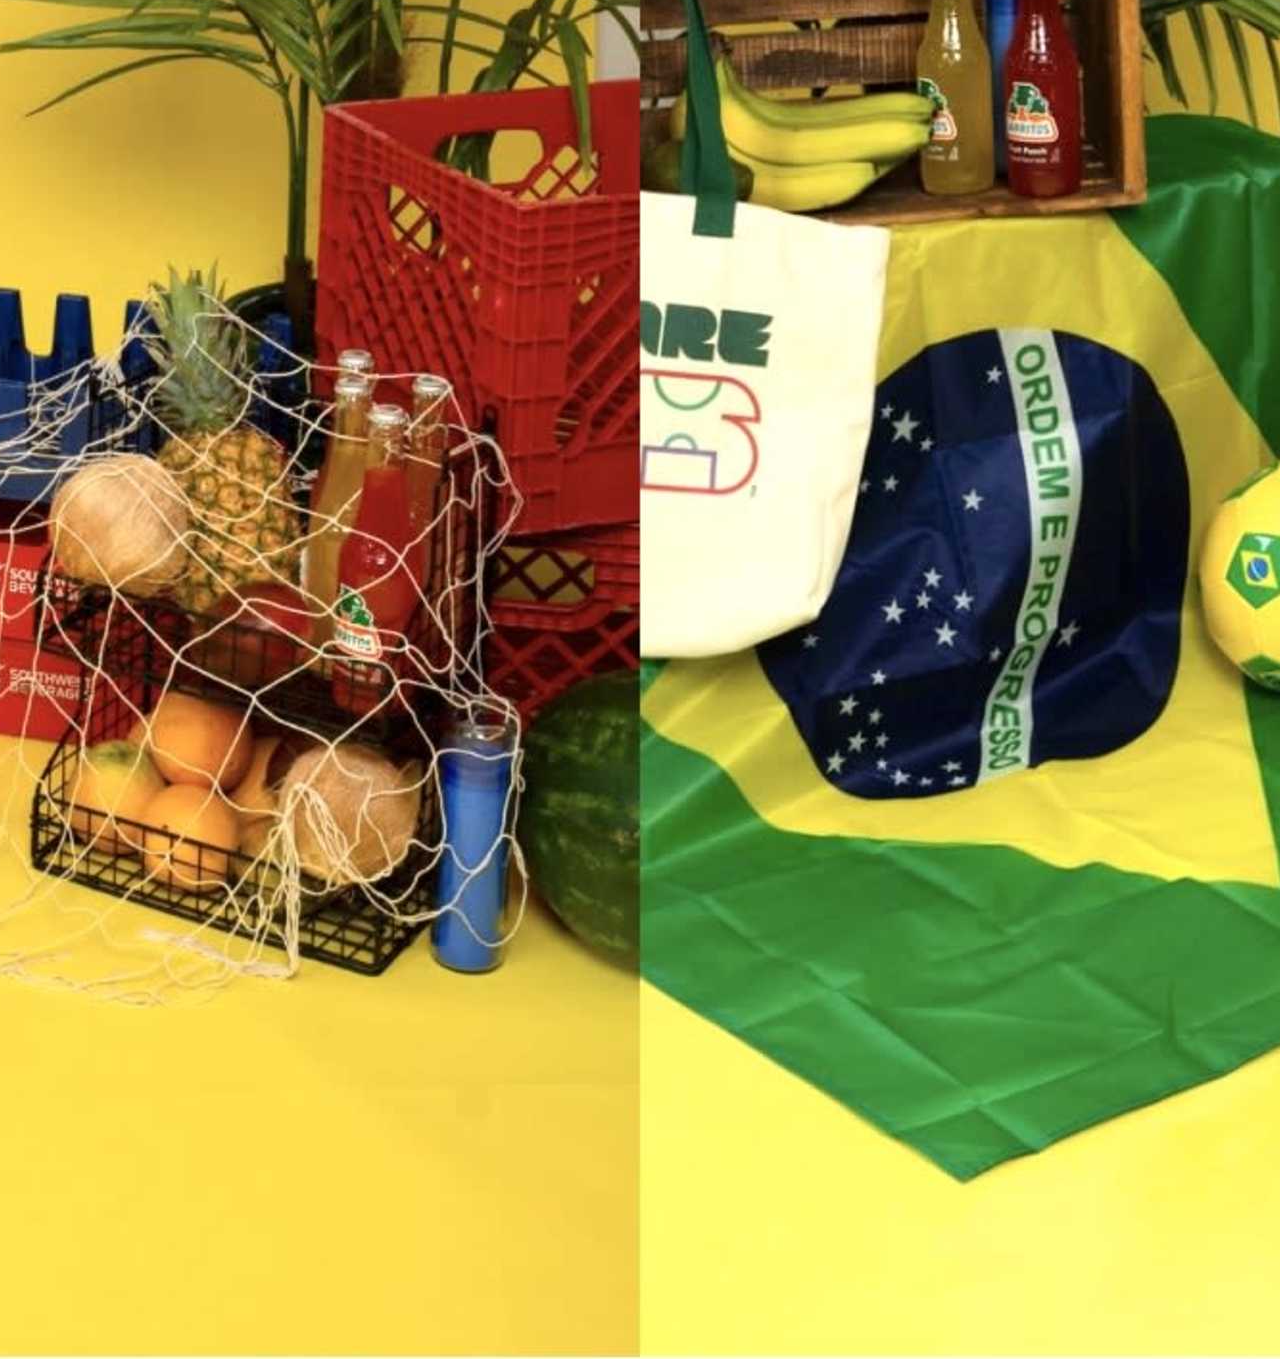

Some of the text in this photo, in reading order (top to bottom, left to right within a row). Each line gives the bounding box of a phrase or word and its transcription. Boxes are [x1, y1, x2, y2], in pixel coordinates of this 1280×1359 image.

[987, 343, 1070, 772] ORDEM E PROGRESSO
